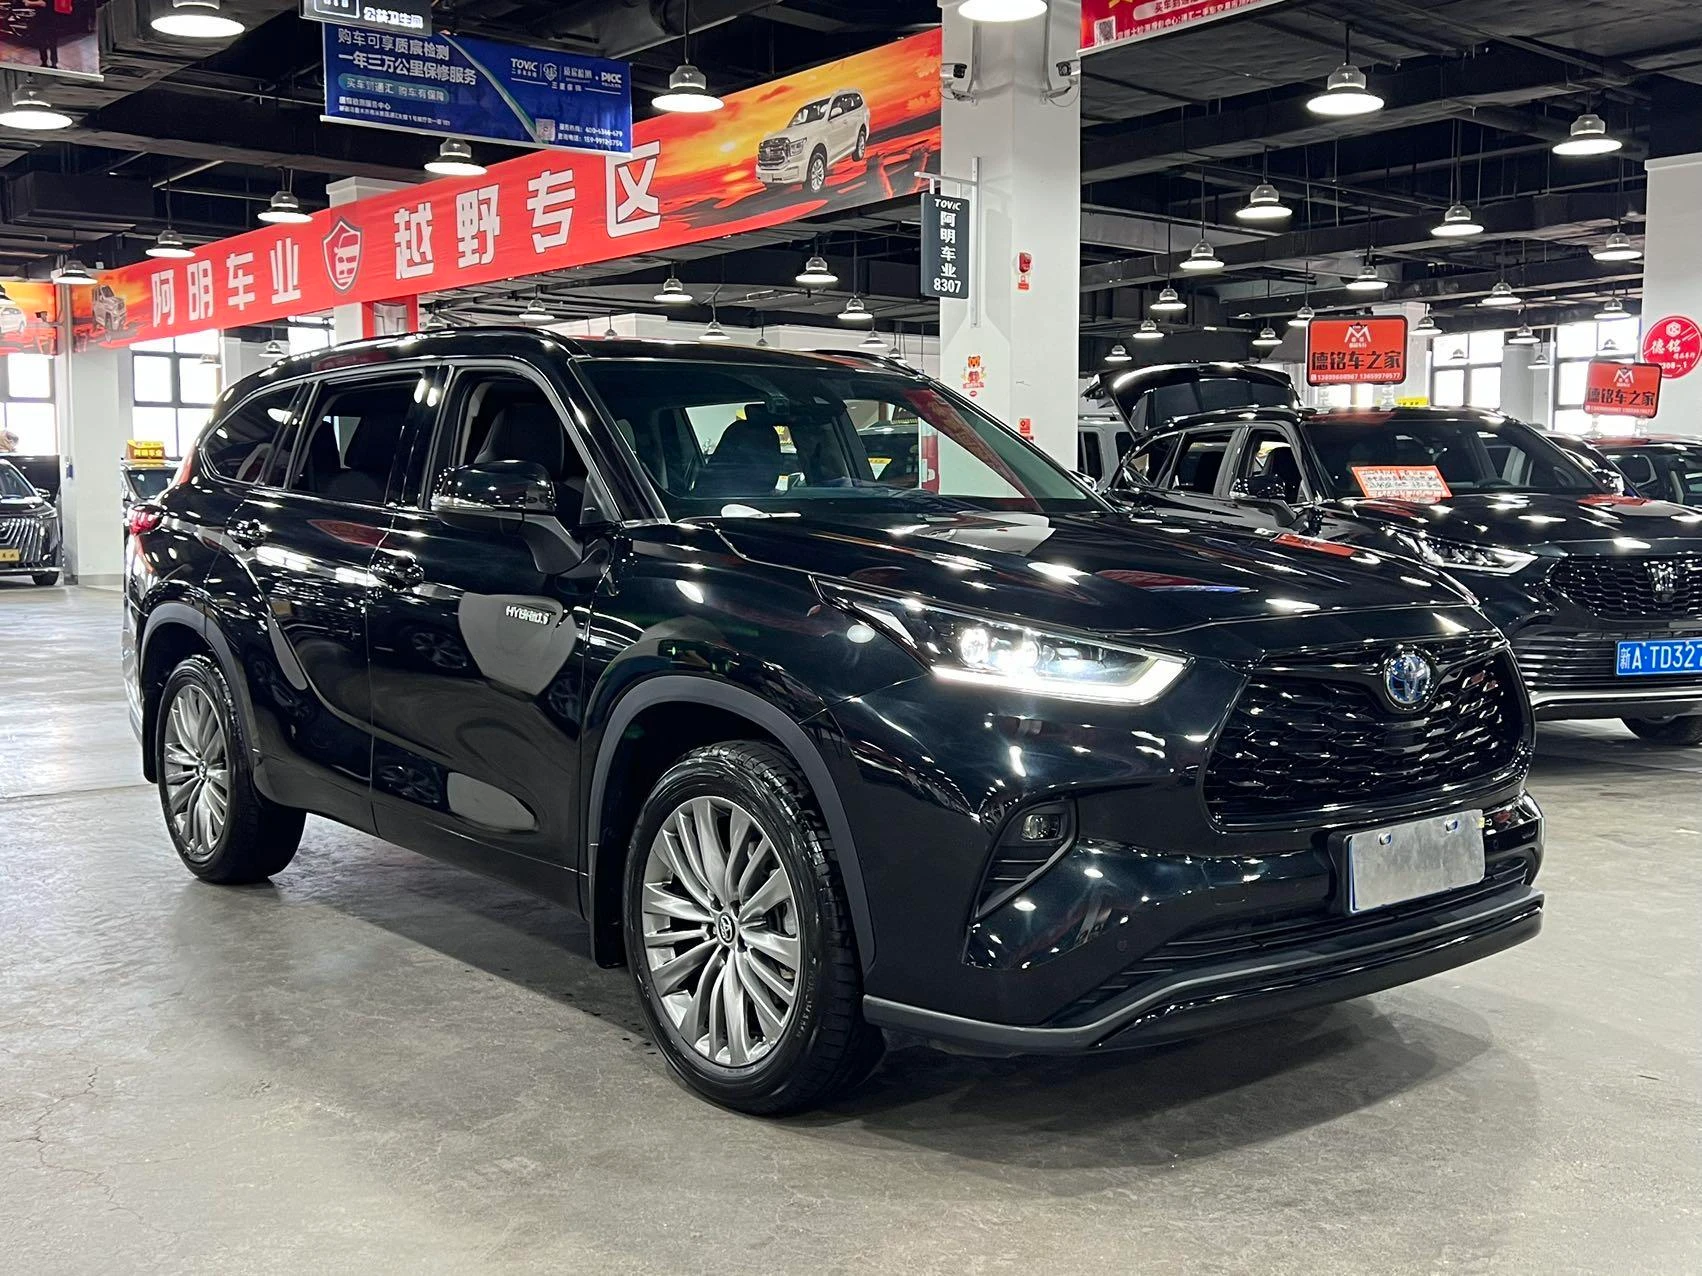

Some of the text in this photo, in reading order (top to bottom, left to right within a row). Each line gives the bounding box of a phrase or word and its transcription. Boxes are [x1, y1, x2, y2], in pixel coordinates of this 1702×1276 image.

[363, 6, 424, 29] 公共卫生间
[338, 51, 477, 85] 一年三万公里保修服务
[398, 85, 444, 102] 购车有保障
[934, 198, 962, 211] TOVIC
[151, 141, 661, 328] 阿明车业 越野专区
[940, 210, 957, 278] 阿明车业
[933, 277, 961, 294] 8307
[1311, 350, 1402, 371] 德铭车之家
[1587, 388, 1656, 407] 德铭车之家
